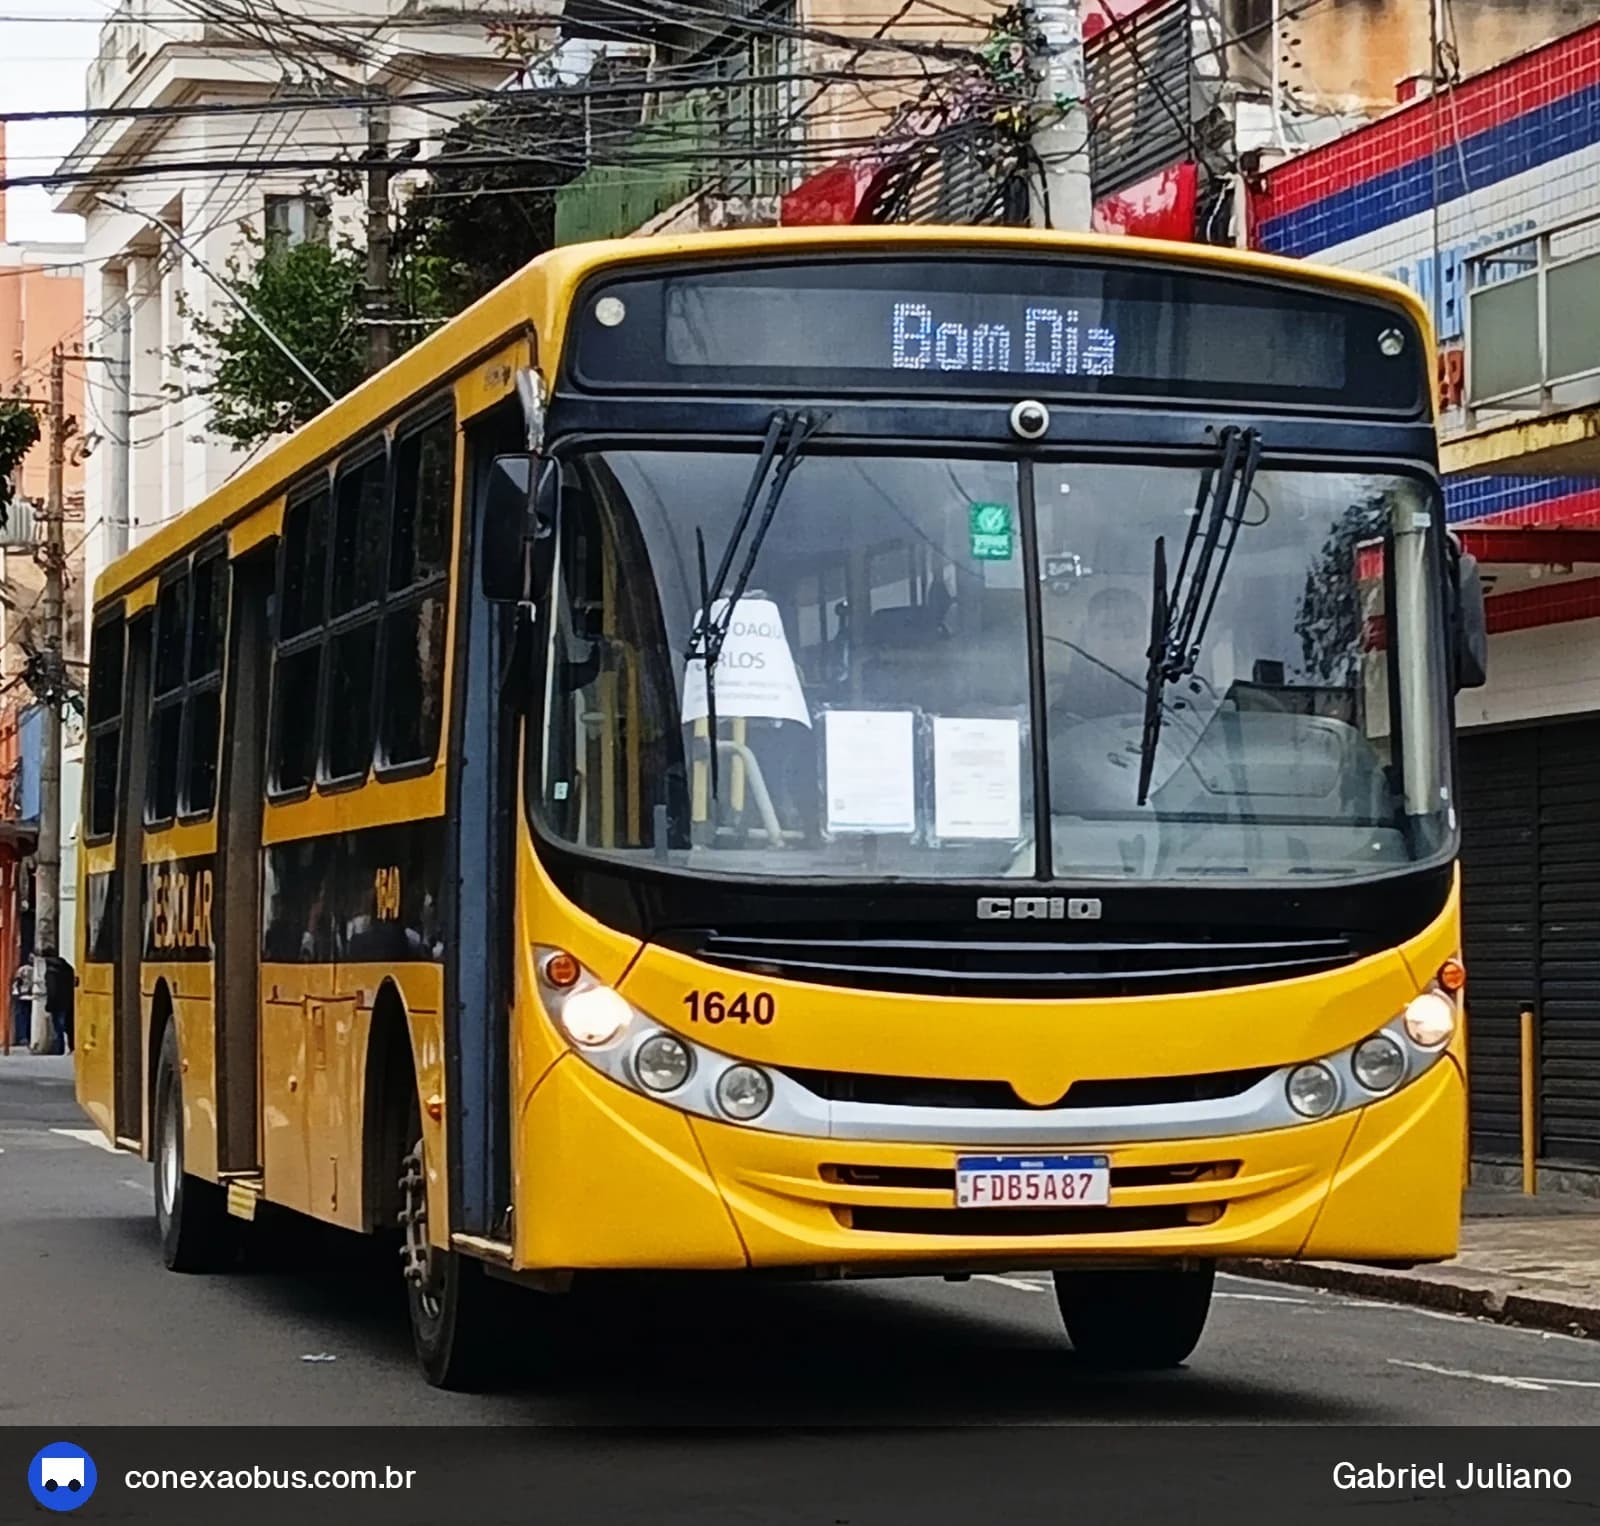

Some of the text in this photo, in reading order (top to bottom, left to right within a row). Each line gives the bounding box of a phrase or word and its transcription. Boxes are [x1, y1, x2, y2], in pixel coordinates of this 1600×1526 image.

[893, 303, 1115, 375] Bom Dia
[154, 869, 214, 949] ESCOLAR
[374, 866, 400, 920] 1640
[976, 897, 1102, 919] CAIO
[683, 990, 775, 1025] 1640
[972, 1173, 1093, 1201] FDB5A87
